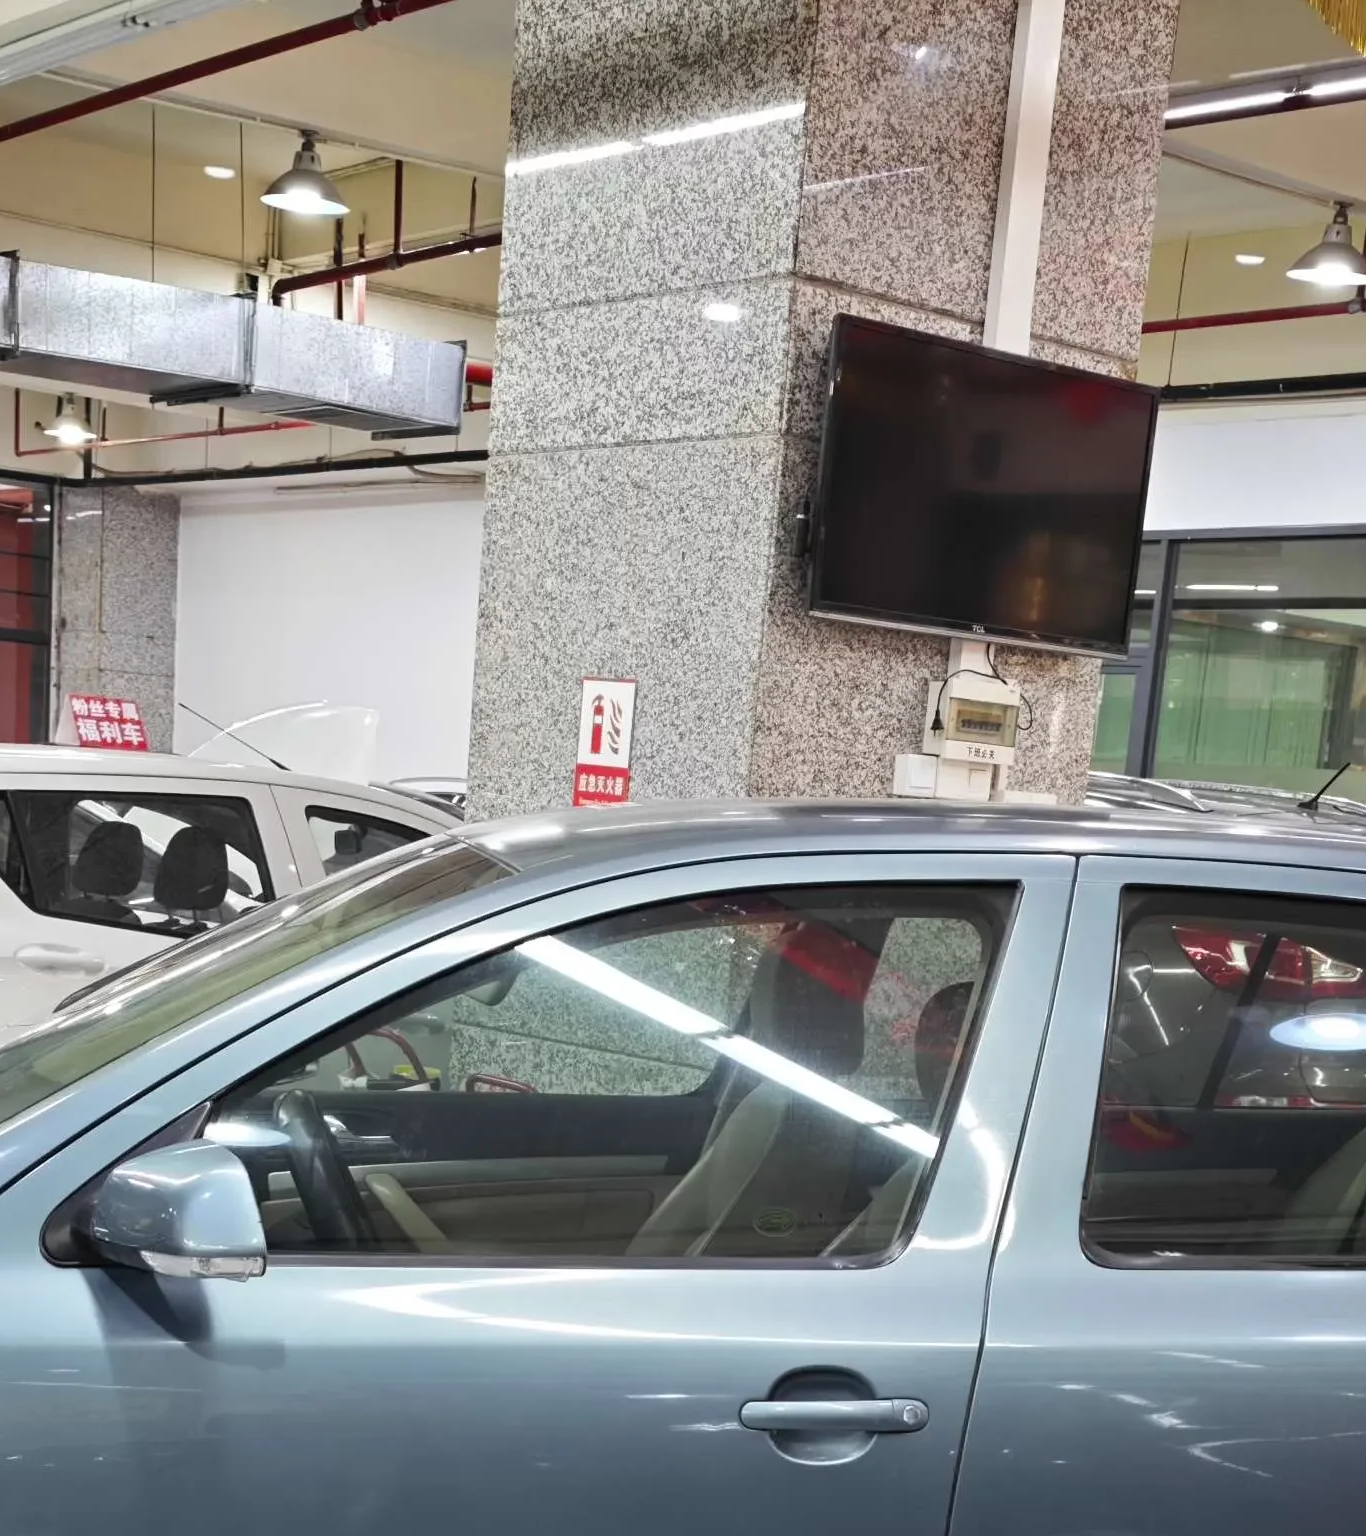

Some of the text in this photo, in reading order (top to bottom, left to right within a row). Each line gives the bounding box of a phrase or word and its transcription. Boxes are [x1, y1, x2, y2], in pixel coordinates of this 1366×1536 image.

[972, 624, 985, 633] TCL
[77, 718, 144, 745] 福利车
